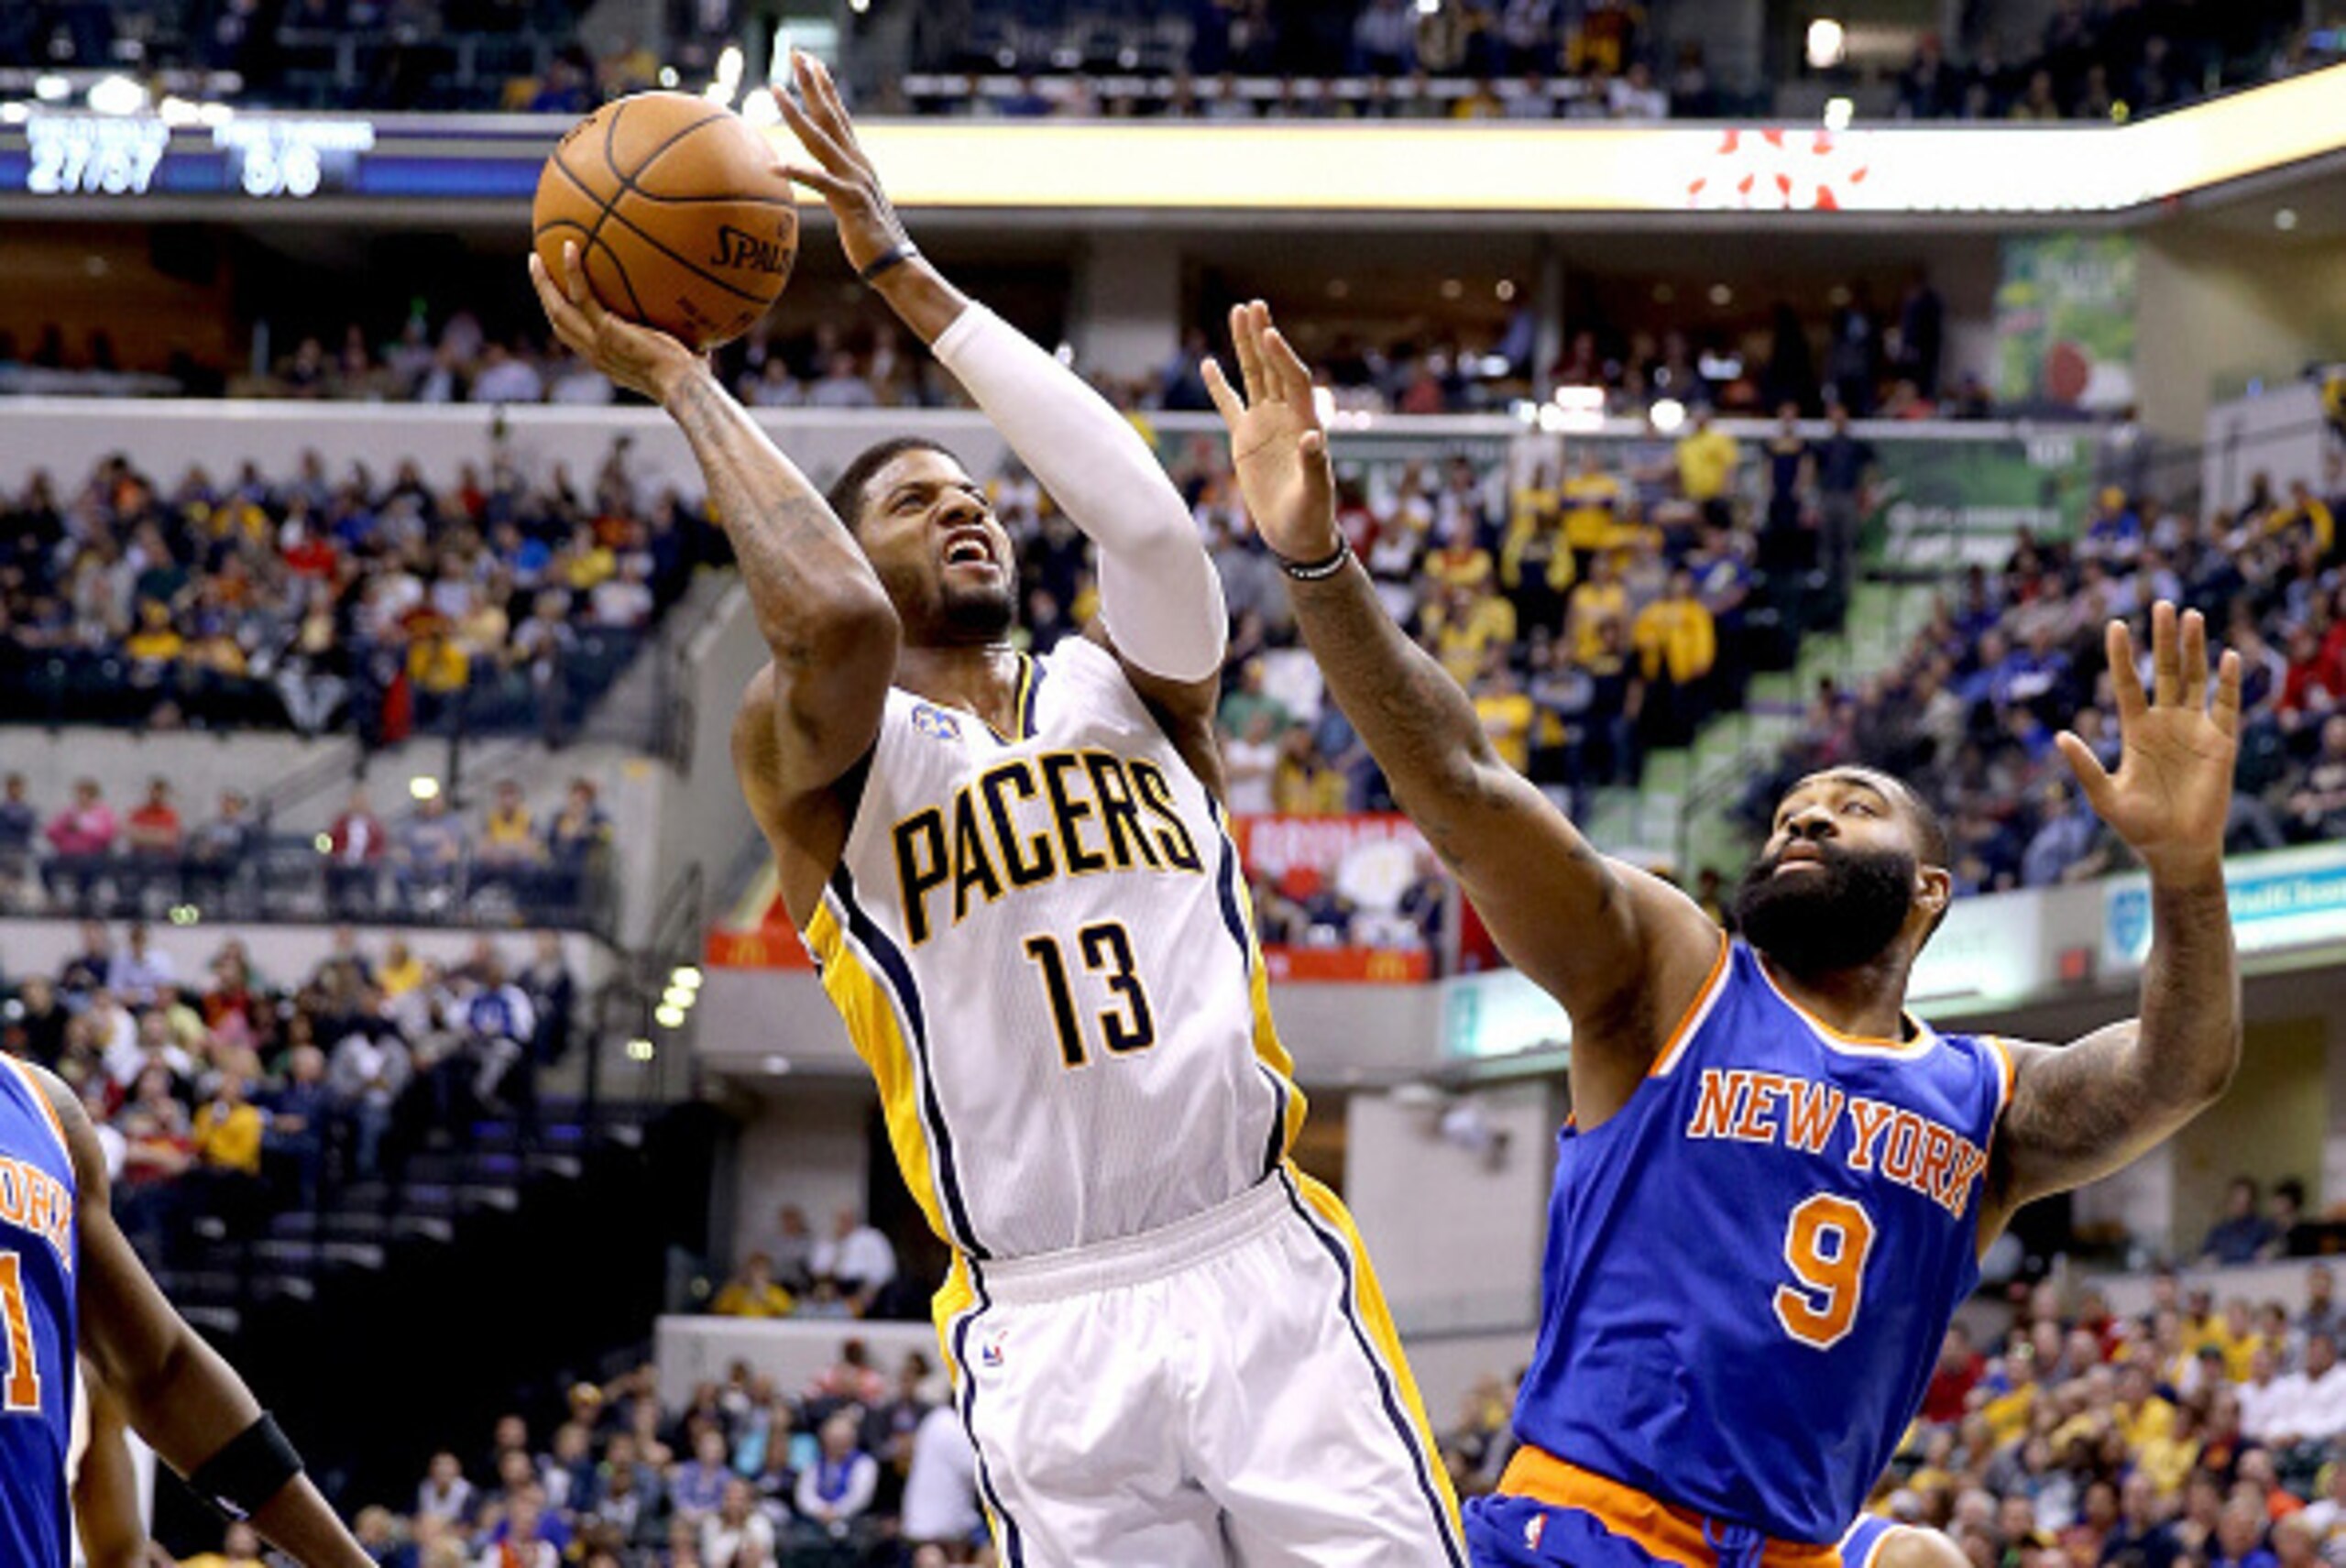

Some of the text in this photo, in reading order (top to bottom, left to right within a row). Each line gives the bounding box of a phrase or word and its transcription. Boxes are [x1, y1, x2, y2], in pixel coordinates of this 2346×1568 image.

[892, 748, 1204, 948] PACERS
[1025, 920, 1155, 1069] 13
[1687, 1069, 1989, 1220] NEW YORK
[1773, 1192, 1876, 1351] 9
